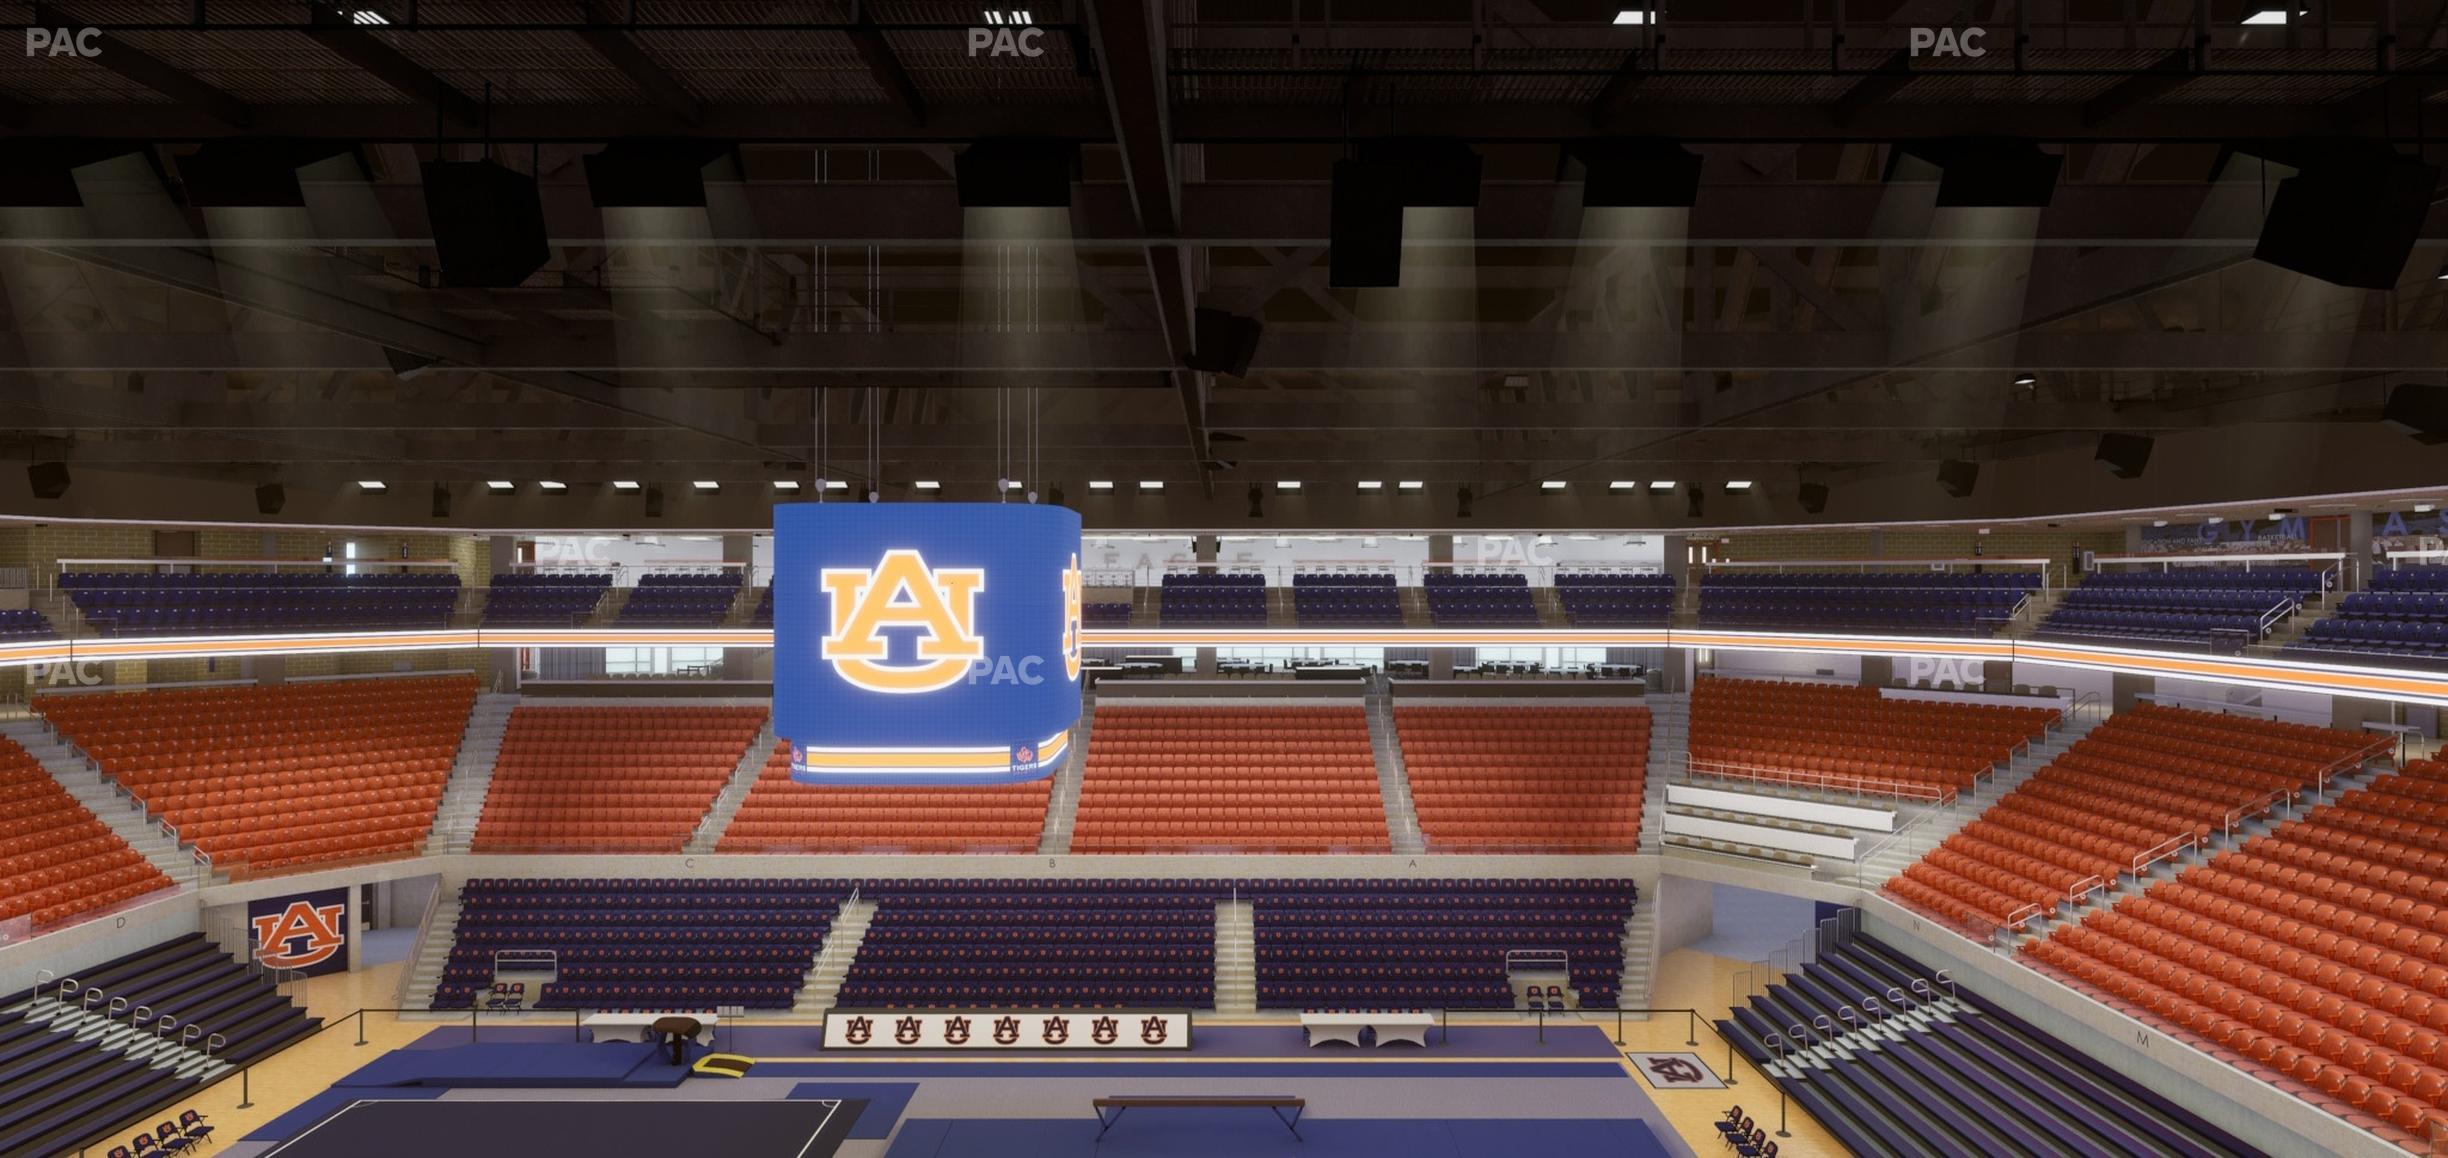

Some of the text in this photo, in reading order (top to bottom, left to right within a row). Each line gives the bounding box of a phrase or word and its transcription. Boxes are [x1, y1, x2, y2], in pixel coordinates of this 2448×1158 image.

[685, 858, 694, 868] C
[1049, 858, 1056, 868] B
[1409, 859, 1417, 868] A
[116, 916, 126, 929] D
[2136, 1031, 2149, 1048] M
